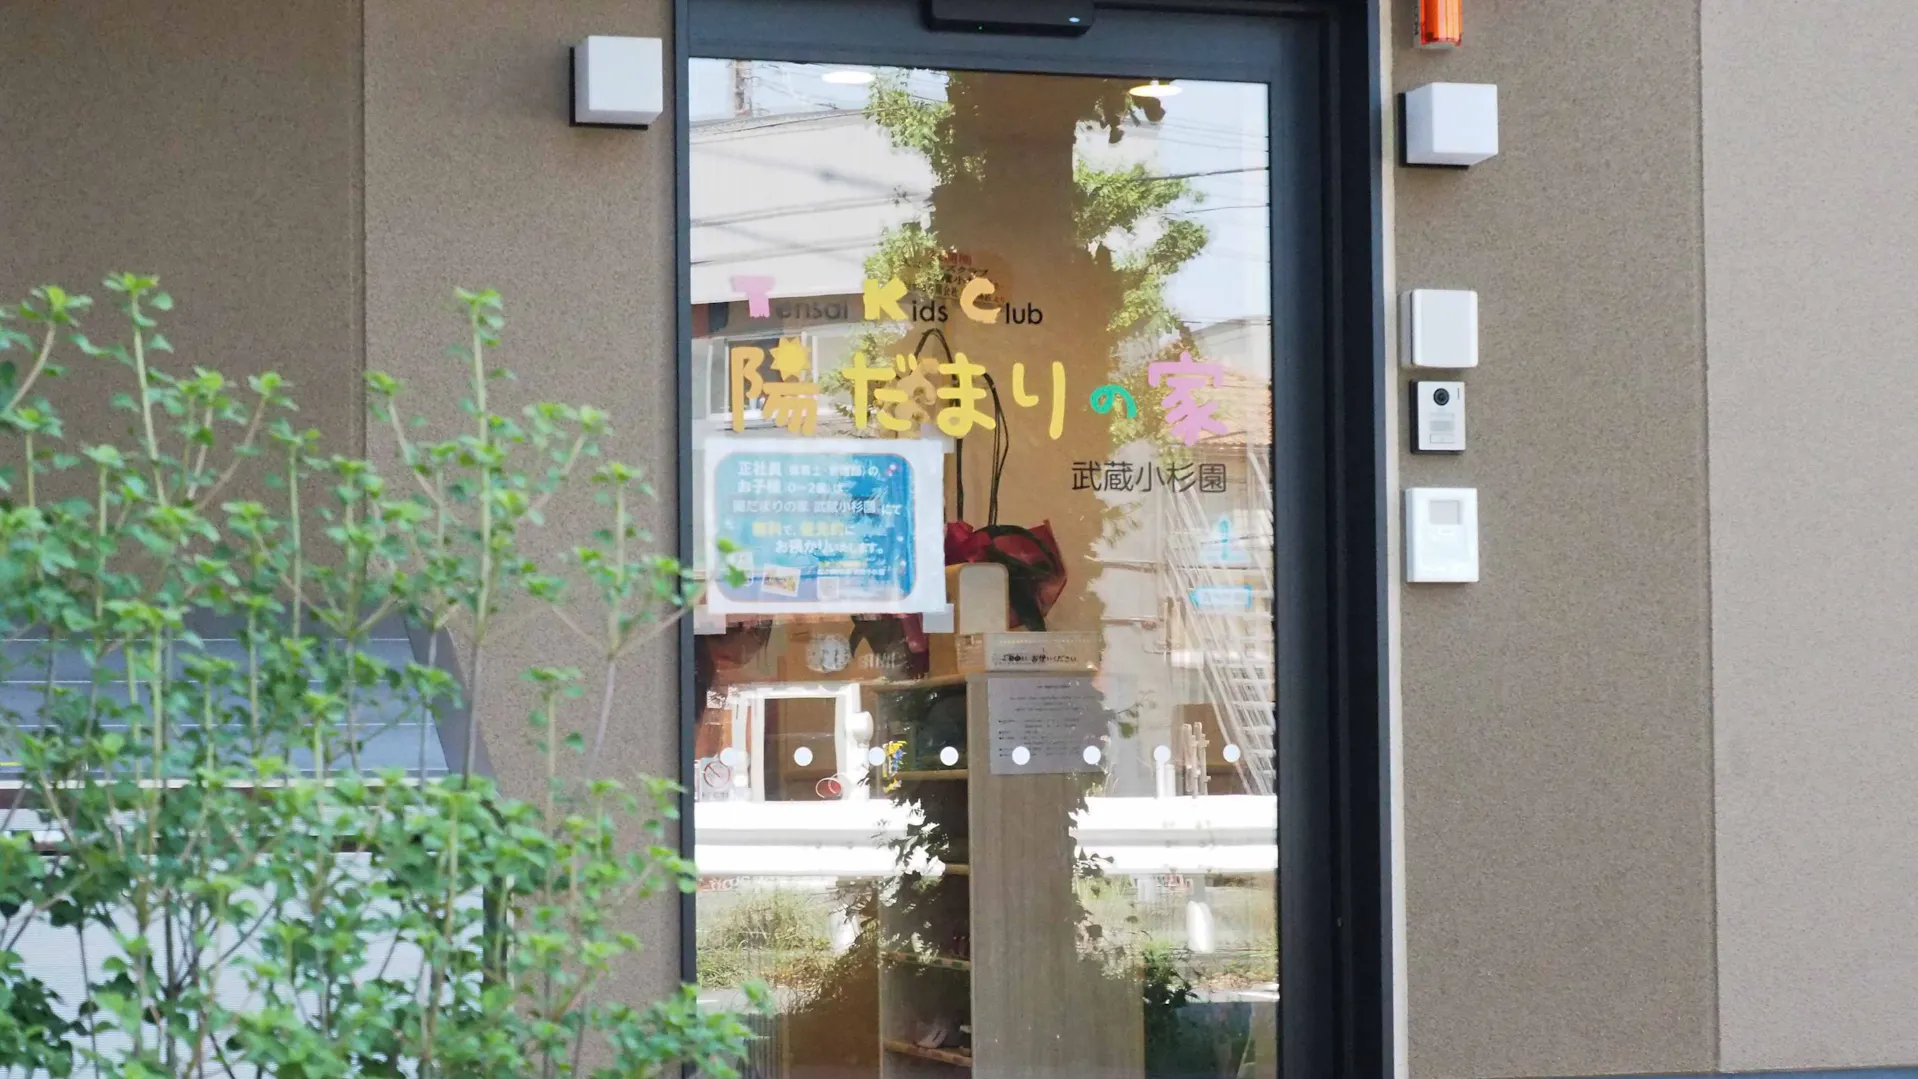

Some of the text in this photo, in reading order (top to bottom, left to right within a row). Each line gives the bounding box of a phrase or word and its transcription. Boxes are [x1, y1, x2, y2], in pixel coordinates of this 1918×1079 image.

[862, 275, 948, 322] Kids
[959, 276, 1043, 325] Club
[729, 337, 1229, 446] 陽だまりの家
[1071, 460, 1227, 494] 武蔵小杉園
